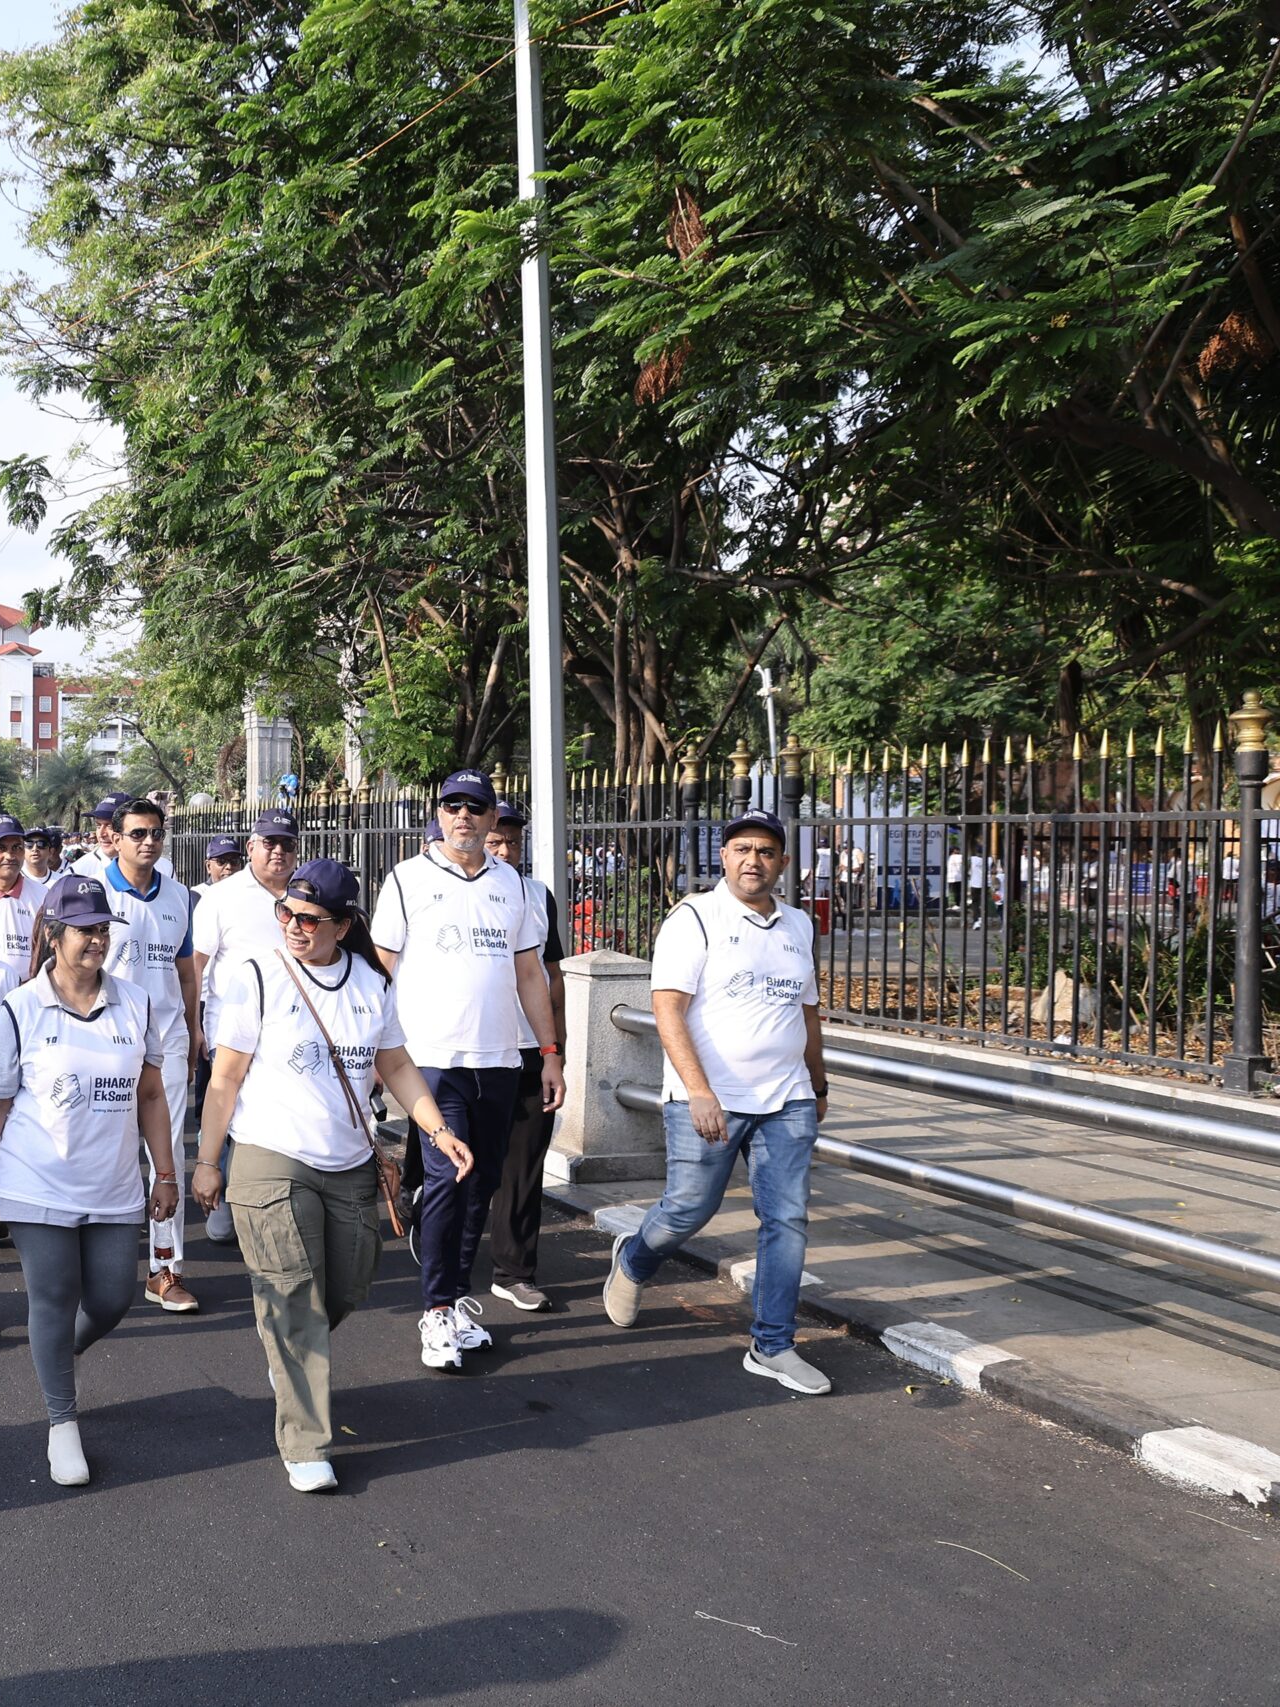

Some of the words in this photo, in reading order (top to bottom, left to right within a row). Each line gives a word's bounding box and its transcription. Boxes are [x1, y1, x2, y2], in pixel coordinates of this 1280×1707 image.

[472, 927, 508, 939] BHARAT
[766, 976, 804, 991] BHARAT
[334, 1045, 376, 1058] BHARAT
[94, 1077, 136, 1089] BHARAT
